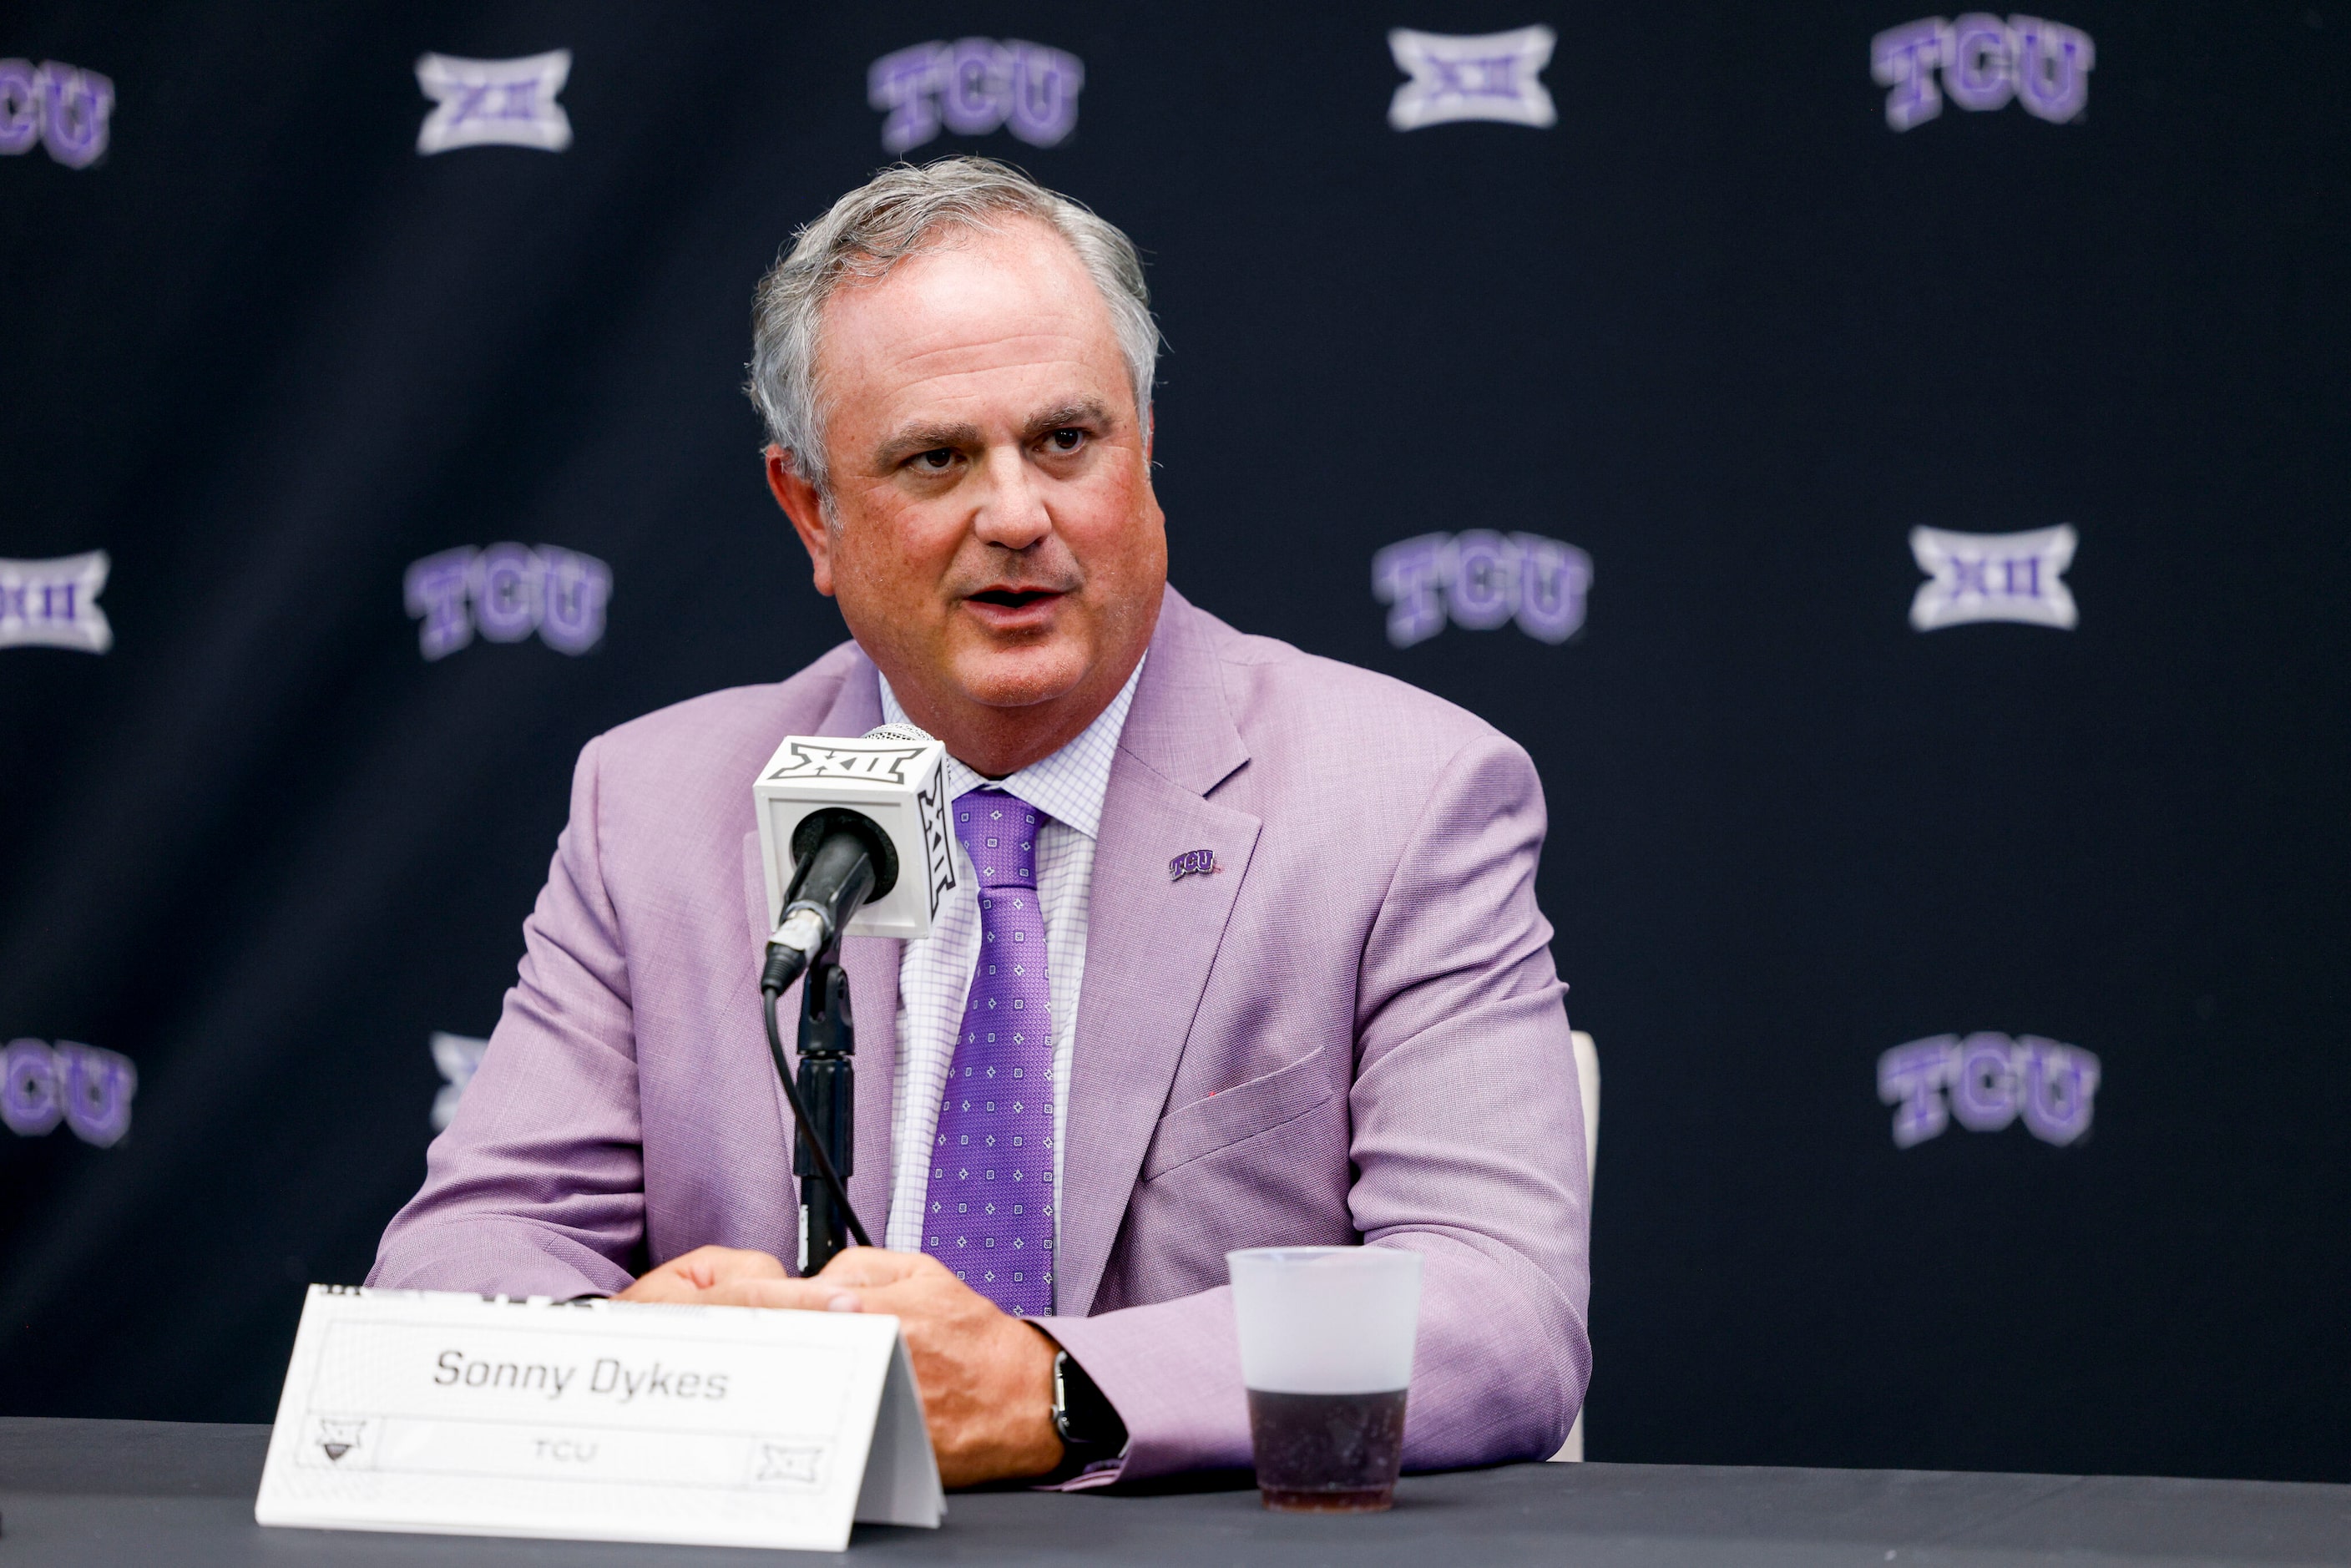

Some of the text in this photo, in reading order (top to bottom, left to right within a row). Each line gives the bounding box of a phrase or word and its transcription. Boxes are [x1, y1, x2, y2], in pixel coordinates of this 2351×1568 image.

[867, 36, 1086, 154] TCU
[1870, 12, 2096, 132] TCU
[403, 541, 614, 660] TCU
[1372, 528, 1593, 645] TCU
[1170, 850, 1215, 881] TCU
[1877, 1031, 2101, 1148] TCU
[433, 1349, 730, 1404] Sonny Dykes
[533, 1438, 599, 1462] TCU
